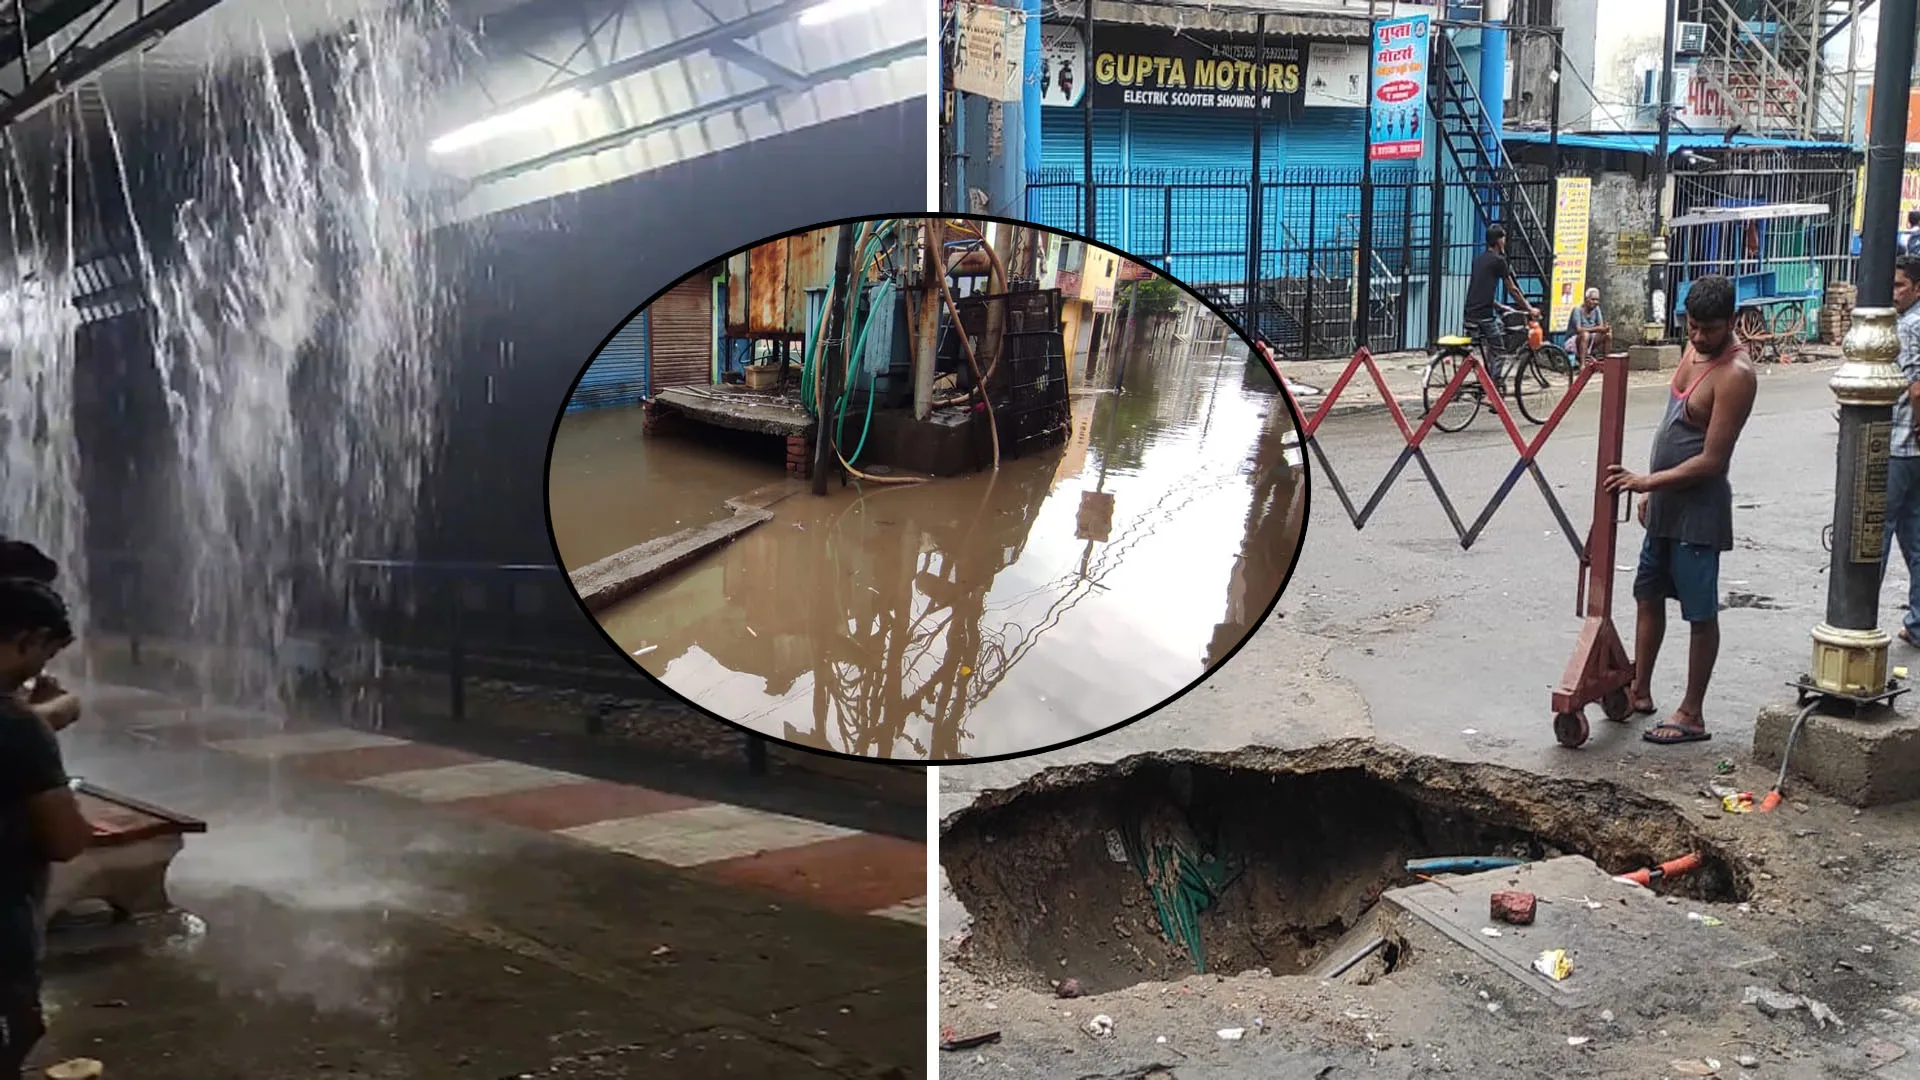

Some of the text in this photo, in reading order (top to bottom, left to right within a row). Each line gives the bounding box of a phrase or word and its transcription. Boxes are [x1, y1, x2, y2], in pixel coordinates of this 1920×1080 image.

[1378, 23, 1411, 44] गुप्ता
[1096, 53, 1299, 93] GUPTA MOTORS
[1124, 90, 1169, 105] ELECTRIC
[1171, 92, 1215, 106] SCOOTER
